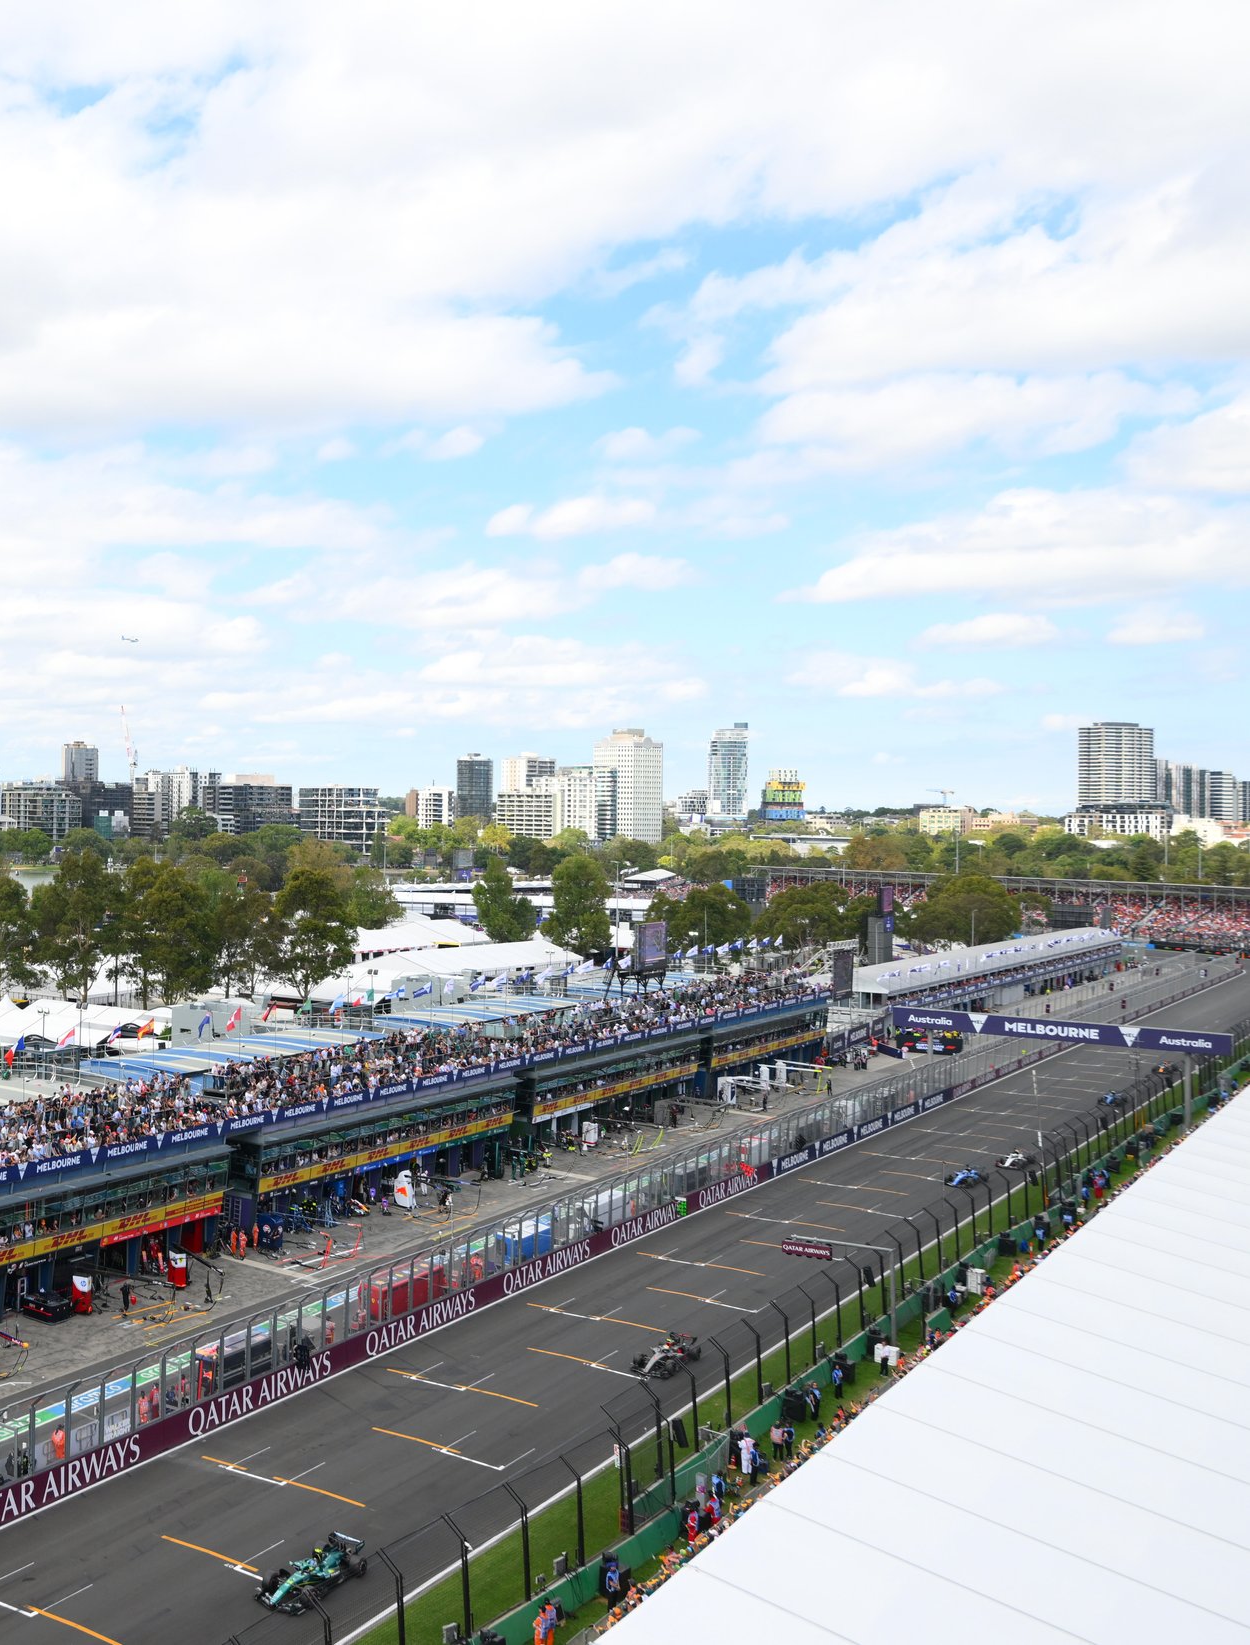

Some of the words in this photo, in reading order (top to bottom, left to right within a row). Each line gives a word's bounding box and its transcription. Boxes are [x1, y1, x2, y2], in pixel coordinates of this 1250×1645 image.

[908, 1014, 952, 1026] Australia
[1004, 1021, 1099, 1039] MELBOURNE
[1159, 1036, 1212, 1048] Australia
[533, 1052, 554, 1061] MELBOURNE
[498, 1059, 520, 1069] MELBOURNE
[462, 1067, 485, 1077] MELBOURNE
[422, 1075, 448, 1086] MELBOURNE
[380, 1084, 407, 1096] MELBOURNE
[602, 1086, 616, 1095] DHL
[334, 1094, 363, 1106] MELBOURNE
[573, 1094, 589, 1102] DHL
[284, 1104, 316, 1118] MELBOURNE
[541, 1102, 558, 1112] DHL
[894, 1105, 914, 1121] MELBOURNE
[230, 1116, 264, 1130] MELBOURNE
[485, 1116, 505, 1128] DHL
[861, 1119, 883, 1136] MELBOURNE
[172, 1128, 208, 1143] MELBOURNE
[448, 1126, 469, 1138] DHL
[108, 1141, 147, 1157] MELBOURNE
[409, 1136, 431, 1148] DHL
[823, 1135, 847, 1152] MELBOURNE
[367, 1148, 390, 1160] DHL
[781, 1151, 808, 1170] MELBOURNE
[37, 1156, 80, 1173] MELBOURNE
[322, 1159, 346, 1173] DHL
[273, 1172, 299, 1187] DHL
[700, 1184, 725, 1208] QATAR
[728, 1170, 758, 1198] AIRWAYS
[118, 1212, 152, 1229] DHL
[51, 1229, 87, 1249] DHL
[611, 1221, 642, 1246] QATAR
[782, 1244, 803, 1252] QATAR
[804, 1248, 830, 1256] AIRWAYS
[504, 1264, 541, 1294] QATAR
[546, 1239, 590, 1278] AIRWAYS
[366, 1321, 415, 1356] QATAR
[420, 1288, 475, 1333] AIRWAYS
[188, 1386, 253, 1436] QATAR
[258, 1350, 331, 1406] AIRWAYS
[43, 1434, 140, 1502] AIRWAYS
